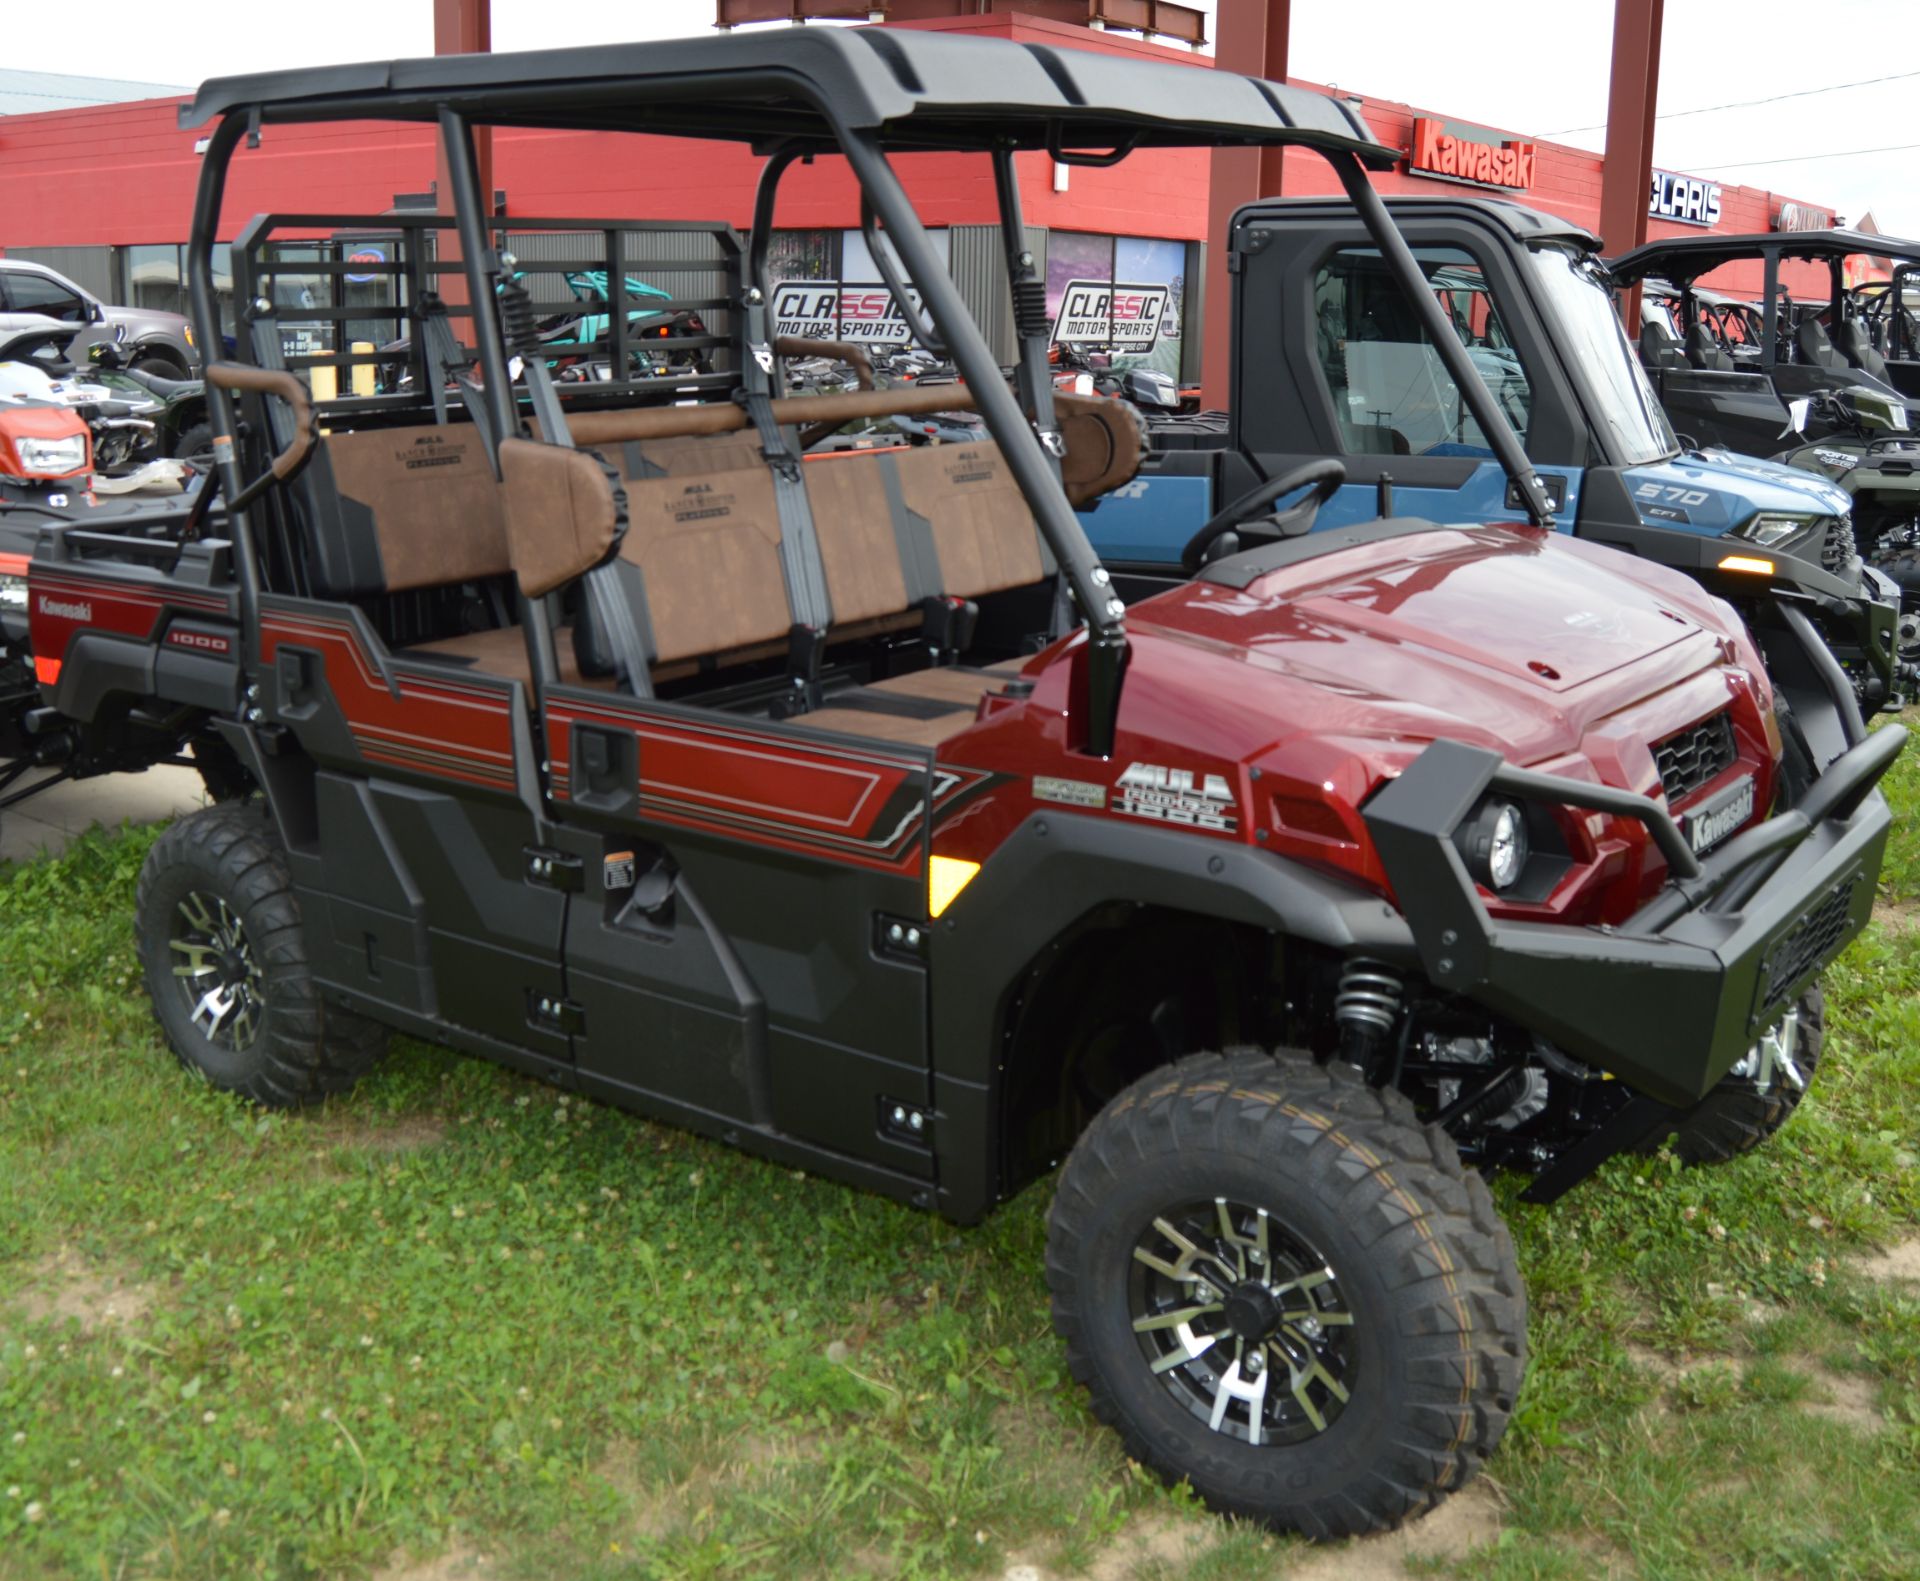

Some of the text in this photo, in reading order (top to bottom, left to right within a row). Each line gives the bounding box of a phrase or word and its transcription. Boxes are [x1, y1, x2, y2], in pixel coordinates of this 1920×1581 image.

[1420, 117, 1537, 190] Kawasaki
[1068, 293, 1160, 320] CLASSIC
[841, 322, 908, 337] SPORTS
[1066, 321, 1154, 336] MOTOR SPORTS
[39, 596, 92, 622] Kawasaki
[172, 633, 227, 650] 1000
[1124, 801, 1226, 829] 1000
[1693, 782, 1754, 852] Kawasaki
